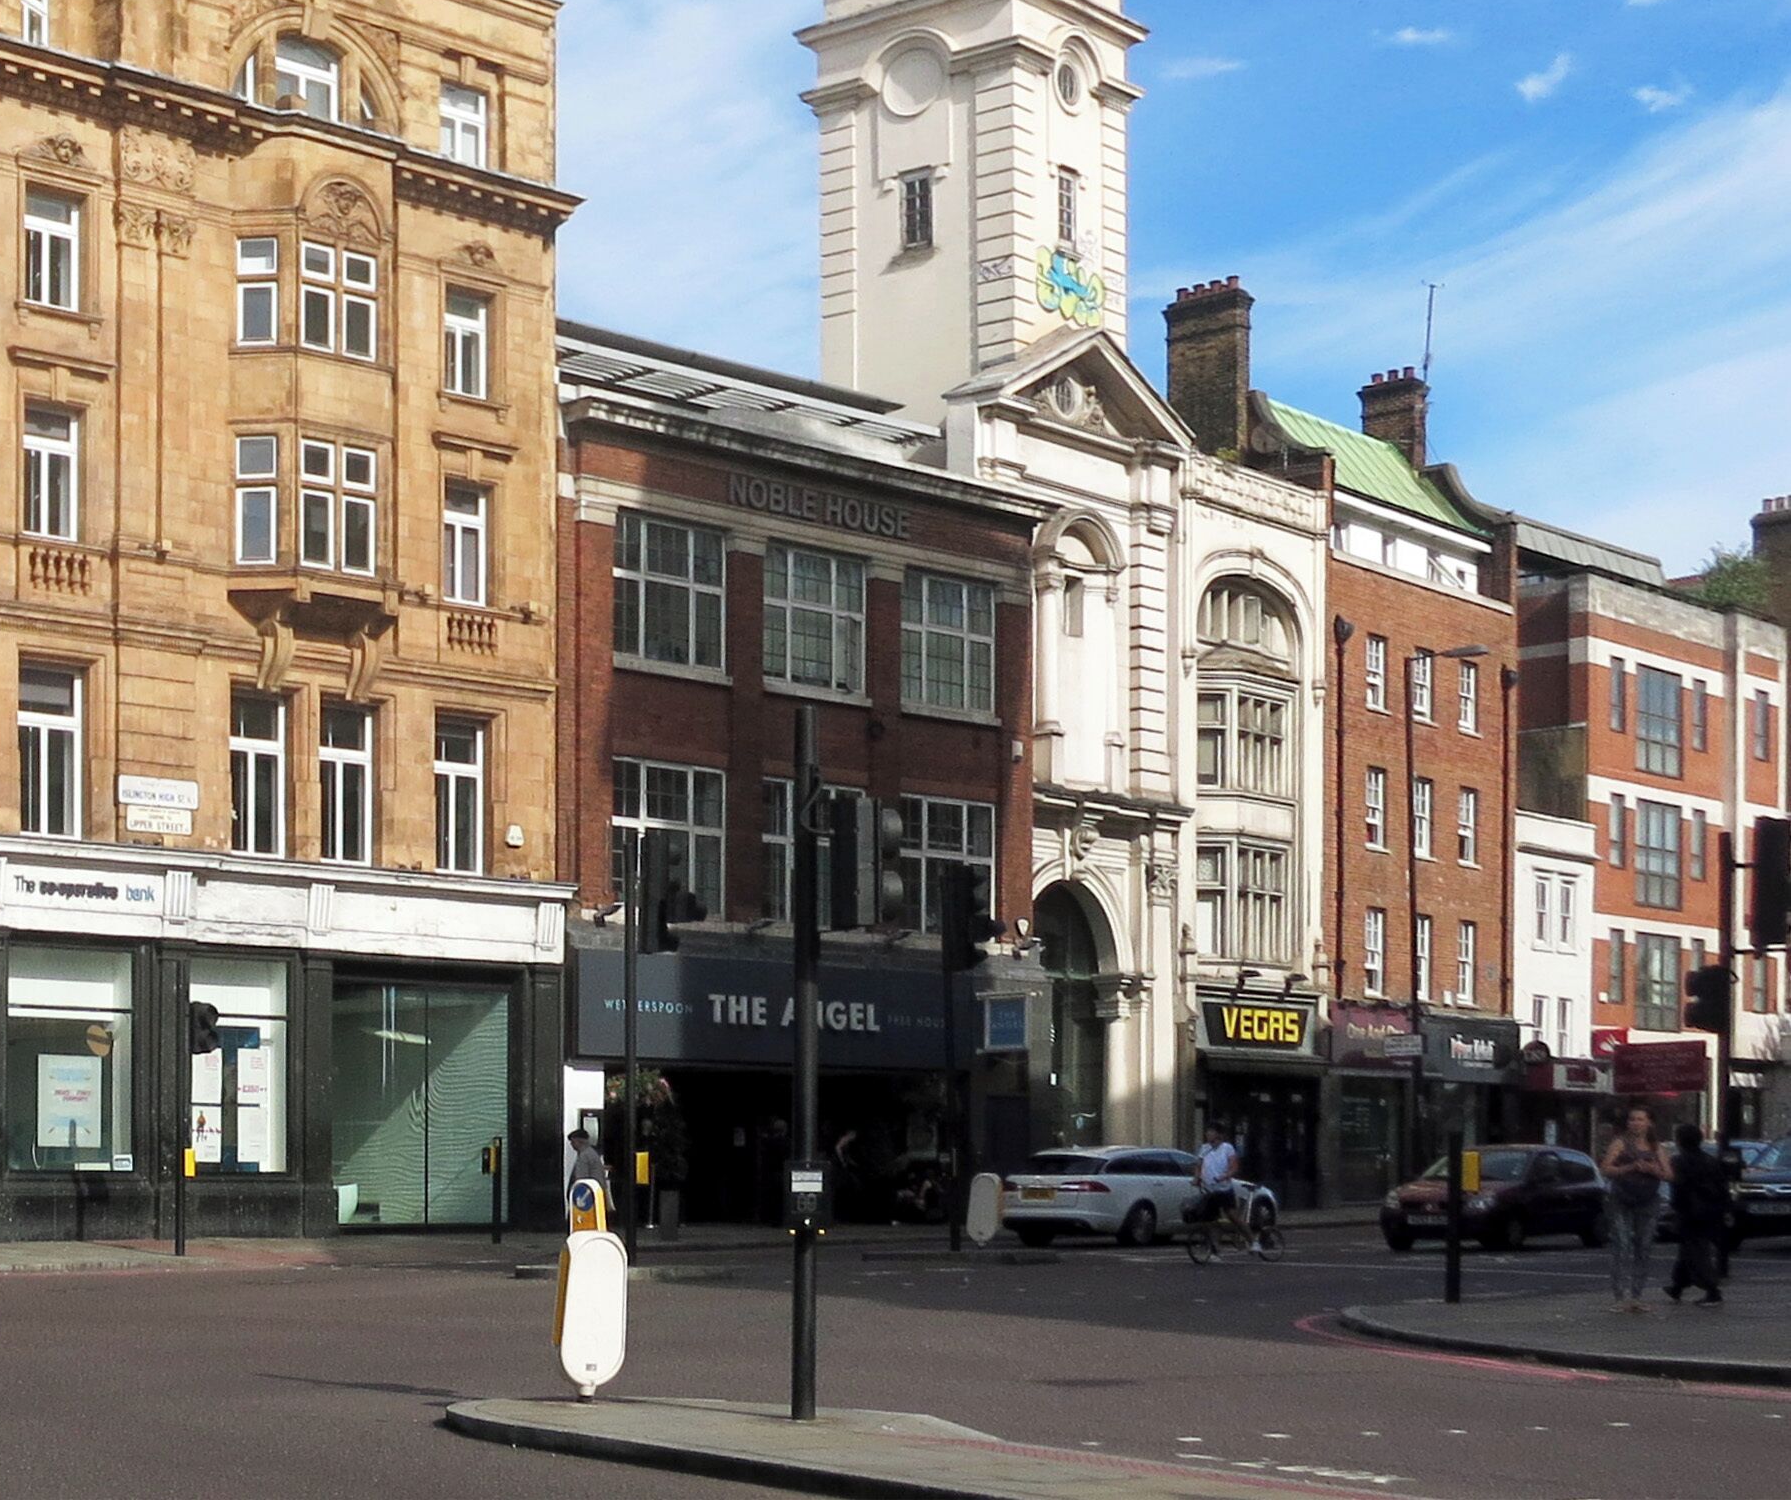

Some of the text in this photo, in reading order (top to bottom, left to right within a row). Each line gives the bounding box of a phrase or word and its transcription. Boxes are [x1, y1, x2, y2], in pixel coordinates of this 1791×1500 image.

[729, 474, 911, 538] NOBLE HOUSE
[157, 821, 184, 832] STREET
[14, 875, 155, 901] The co-operative bank
[604, 999, 694, 1014] WETERSPOON
[708, 994, 880, 1032] THE AGEL
[1221, 1006, 1299, 1043] VEGAS
